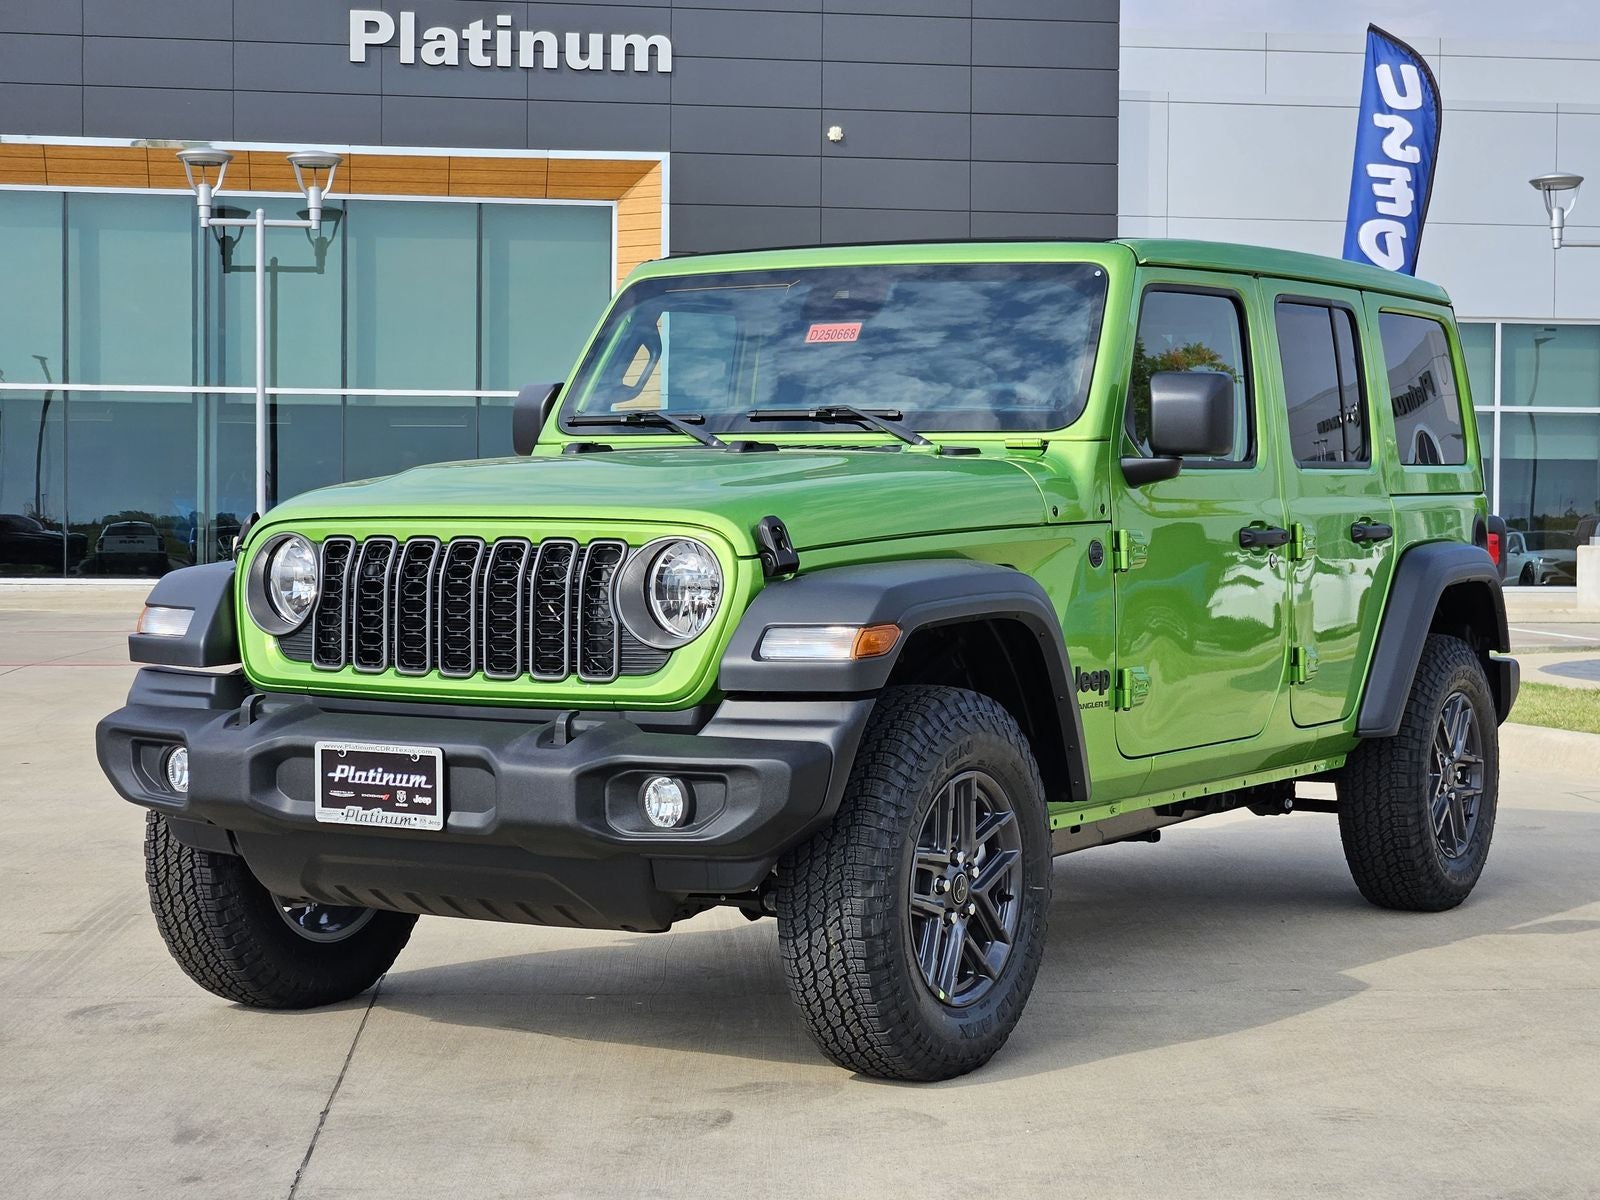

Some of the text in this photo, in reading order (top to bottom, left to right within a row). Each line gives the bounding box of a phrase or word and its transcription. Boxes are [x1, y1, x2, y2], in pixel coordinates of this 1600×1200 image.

[349, 9, 673, 73] Platinum
[810, 328, 856, 340] D250668
[1075, 666, 1110, 695] Jeep
[1079, 701, 1103, 709] ANGLER
[327, 764, 433, 789] Platinum
[413, 794, 432, 805] Jeep
[344, 808, 412, 826] Platinum
